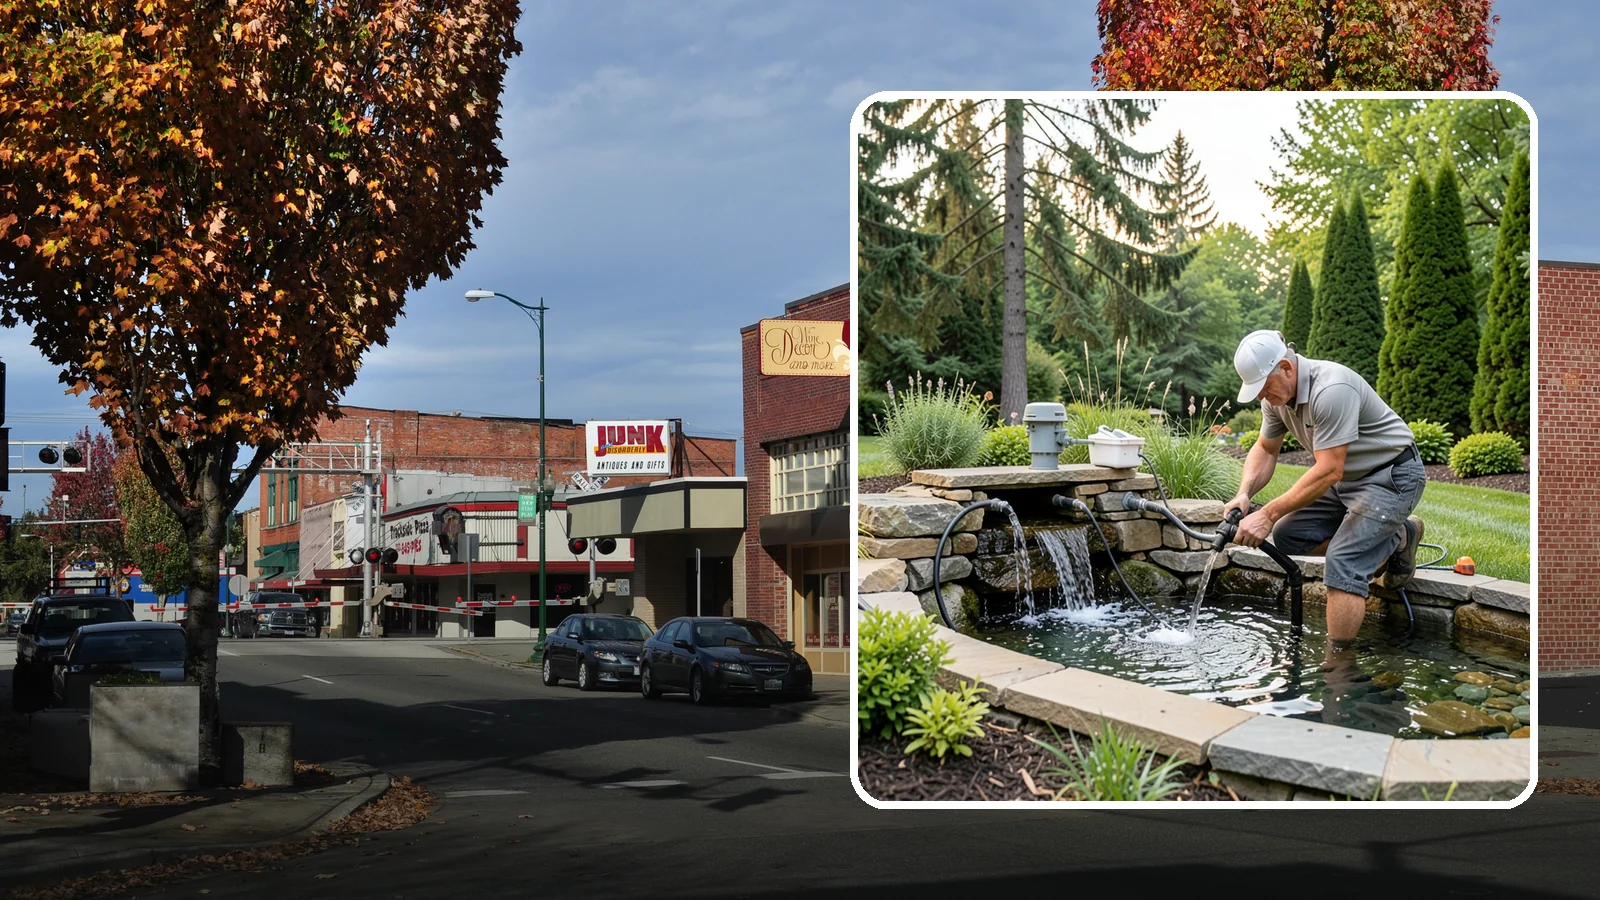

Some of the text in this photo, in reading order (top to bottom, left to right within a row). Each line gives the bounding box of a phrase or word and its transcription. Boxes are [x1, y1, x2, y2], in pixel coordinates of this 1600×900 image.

[596, 425, 665, 457] JUNK
[597, 460, 665, 470] ANTIQUES AND GIFTS
[414, 519, 429, 535] Pizza
